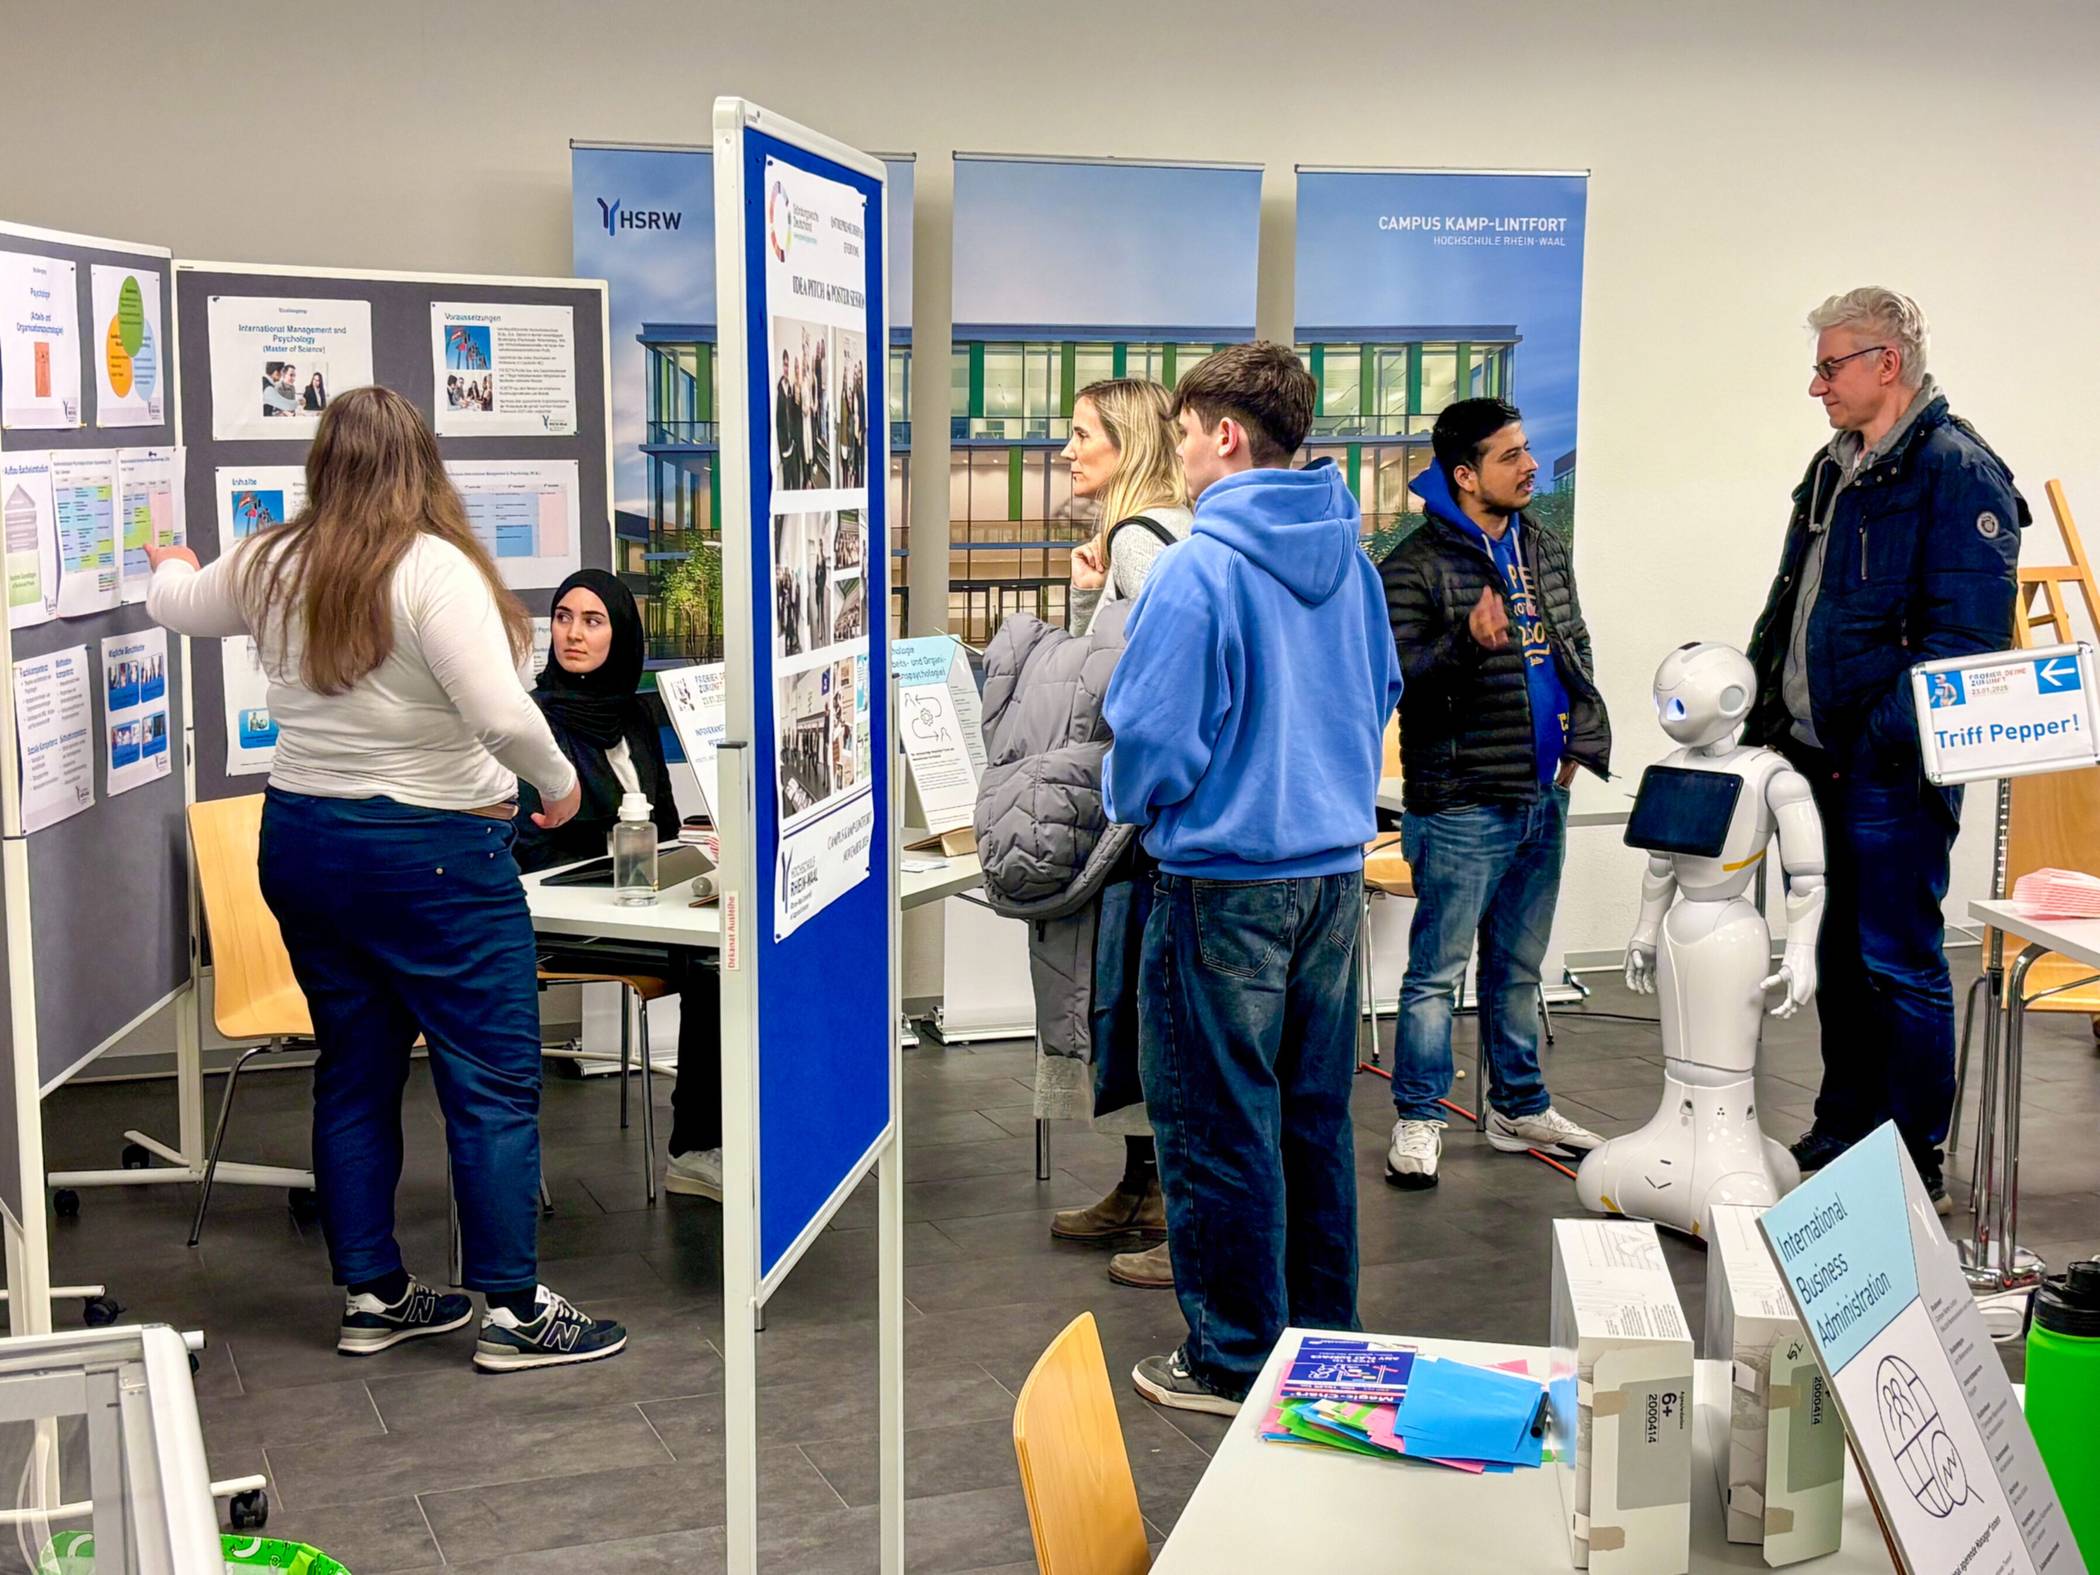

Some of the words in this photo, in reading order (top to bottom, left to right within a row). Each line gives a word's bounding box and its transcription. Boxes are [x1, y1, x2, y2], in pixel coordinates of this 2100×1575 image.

[620, 210, 682, 230] HSRW
[1378, 216, 1441, 231] CAMPUS
[1445, 217, 1567, 232] KAMP-LINTFORT
[1433, 236, 1501, 246] HOCHSCHULE
[1503, 237, 1566, 247] RHEIN-WAAL
[238, 324, 286, 333] International
[287, 325, 333, 335] Management
[334, 326, 347, 335] and
[444, 312, 502, 323] Voraussetzungen
[263, 345, 289, 353] (Master
[289, 345, 297, 353] of
[297, 345, 326, 354] Science)
[272, 335, 316, 344] Psychology
[1935, 725, 1984, 749] Triff
[1989, 714, 2080, 743] Pepper!
[1776, 1192, 1849, 1263] International
[1797, 1251, 1849, 1305] Business
[409, 1295, 435, 1323] N
[1816, 1270, 1893, 1348] Administration
[544, 1321, 580, 1352] N
[1661, 1392, 1677, 1418] 6+
[1811, 1377, 1823, 1426] 2000414
[1647, 1394, 1659, 1445] 2000414
